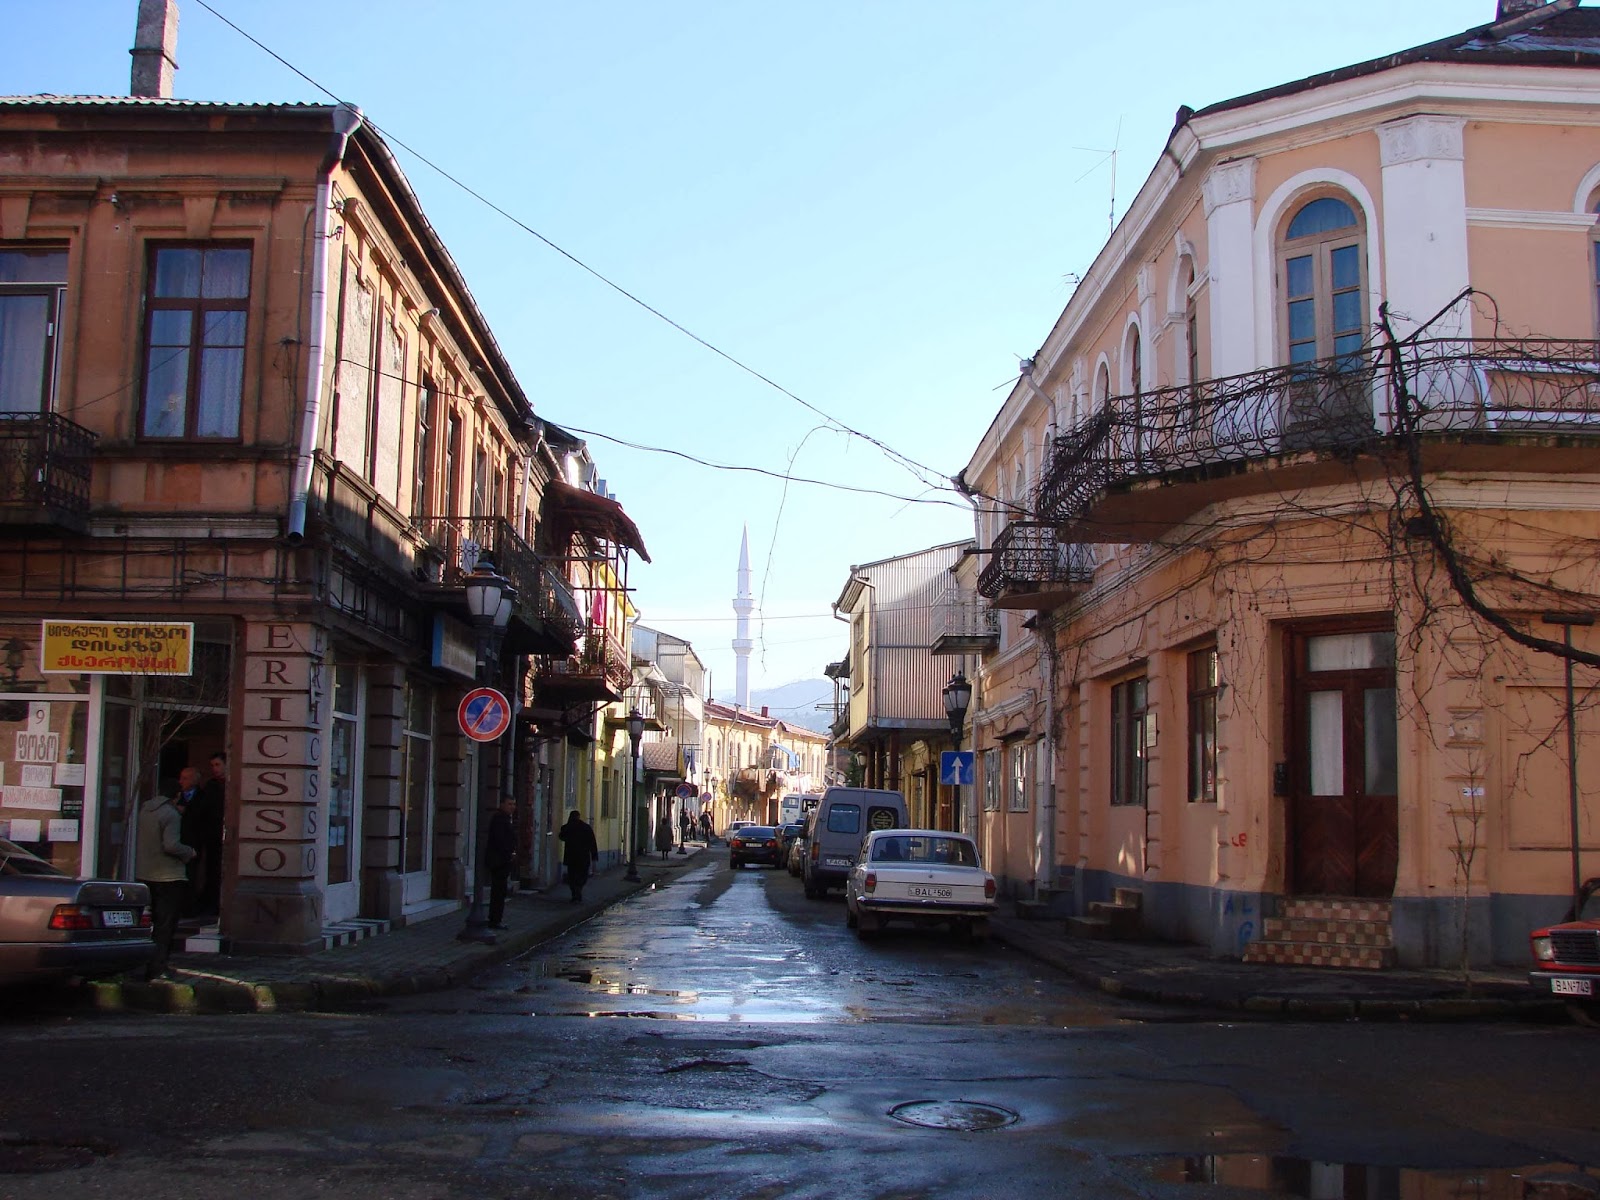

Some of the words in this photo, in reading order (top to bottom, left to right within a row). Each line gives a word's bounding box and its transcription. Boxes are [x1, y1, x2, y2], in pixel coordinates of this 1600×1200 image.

[48, 625, 108, 638] ციფრული
[113, 626, 187, 639] ფოტო
[71, 639, 163, 653] დისკზე
[57, 655, 177, 669] ქსეროქსი
[35, 709, 46, 725] 9
[17, 733, 58, 760] ფოტო
